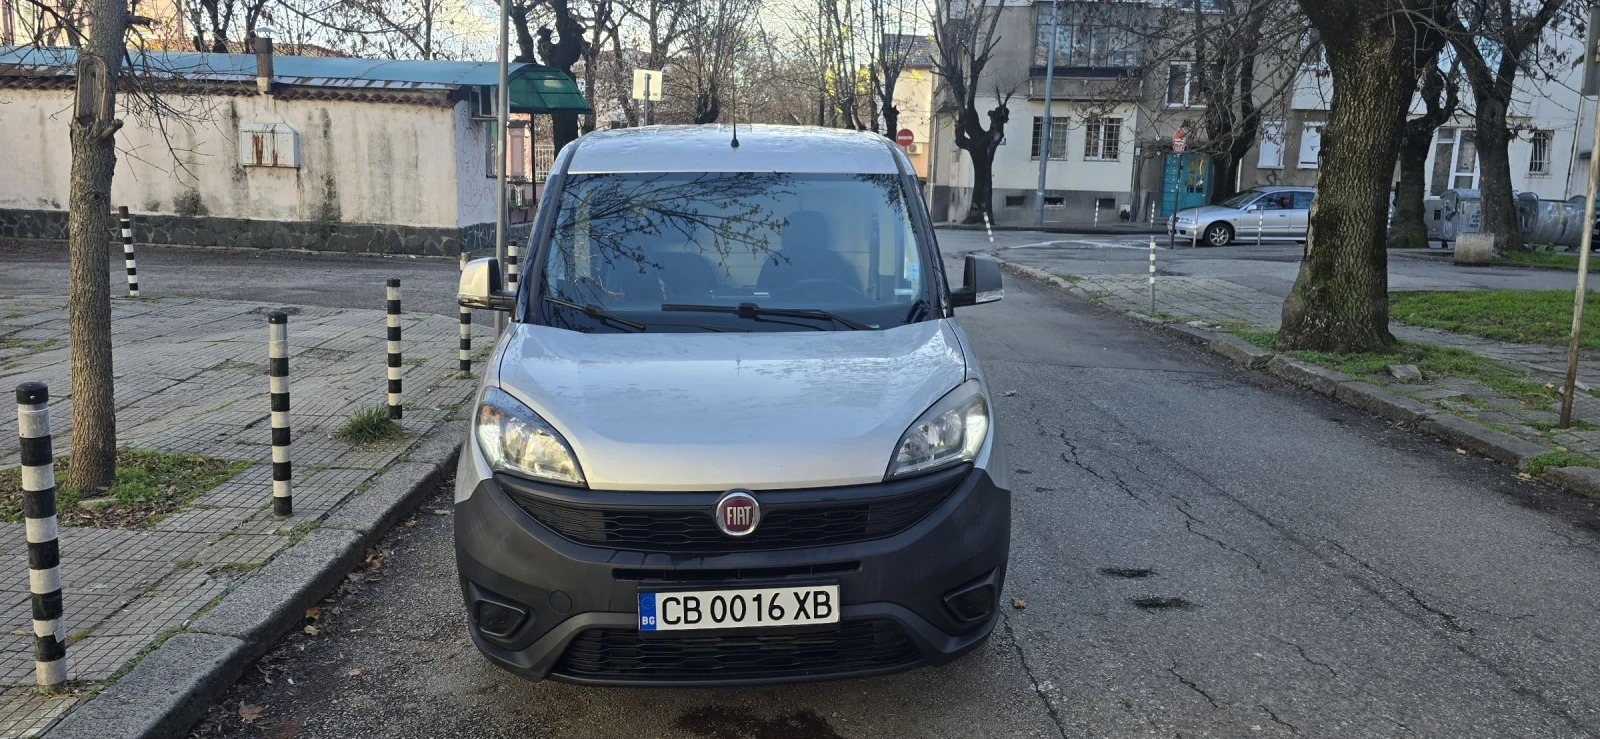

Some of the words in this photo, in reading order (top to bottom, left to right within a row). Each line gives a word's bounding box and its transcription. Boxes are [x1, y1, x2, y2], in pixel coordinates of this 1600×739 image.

[726, 506, 752, 525] FIAT
[661, 596, 702, 625] CB
[710, 592, 785, 623] 0016
[793, 590, 832, 621] XB
[641, 616, 655, 625] BG
